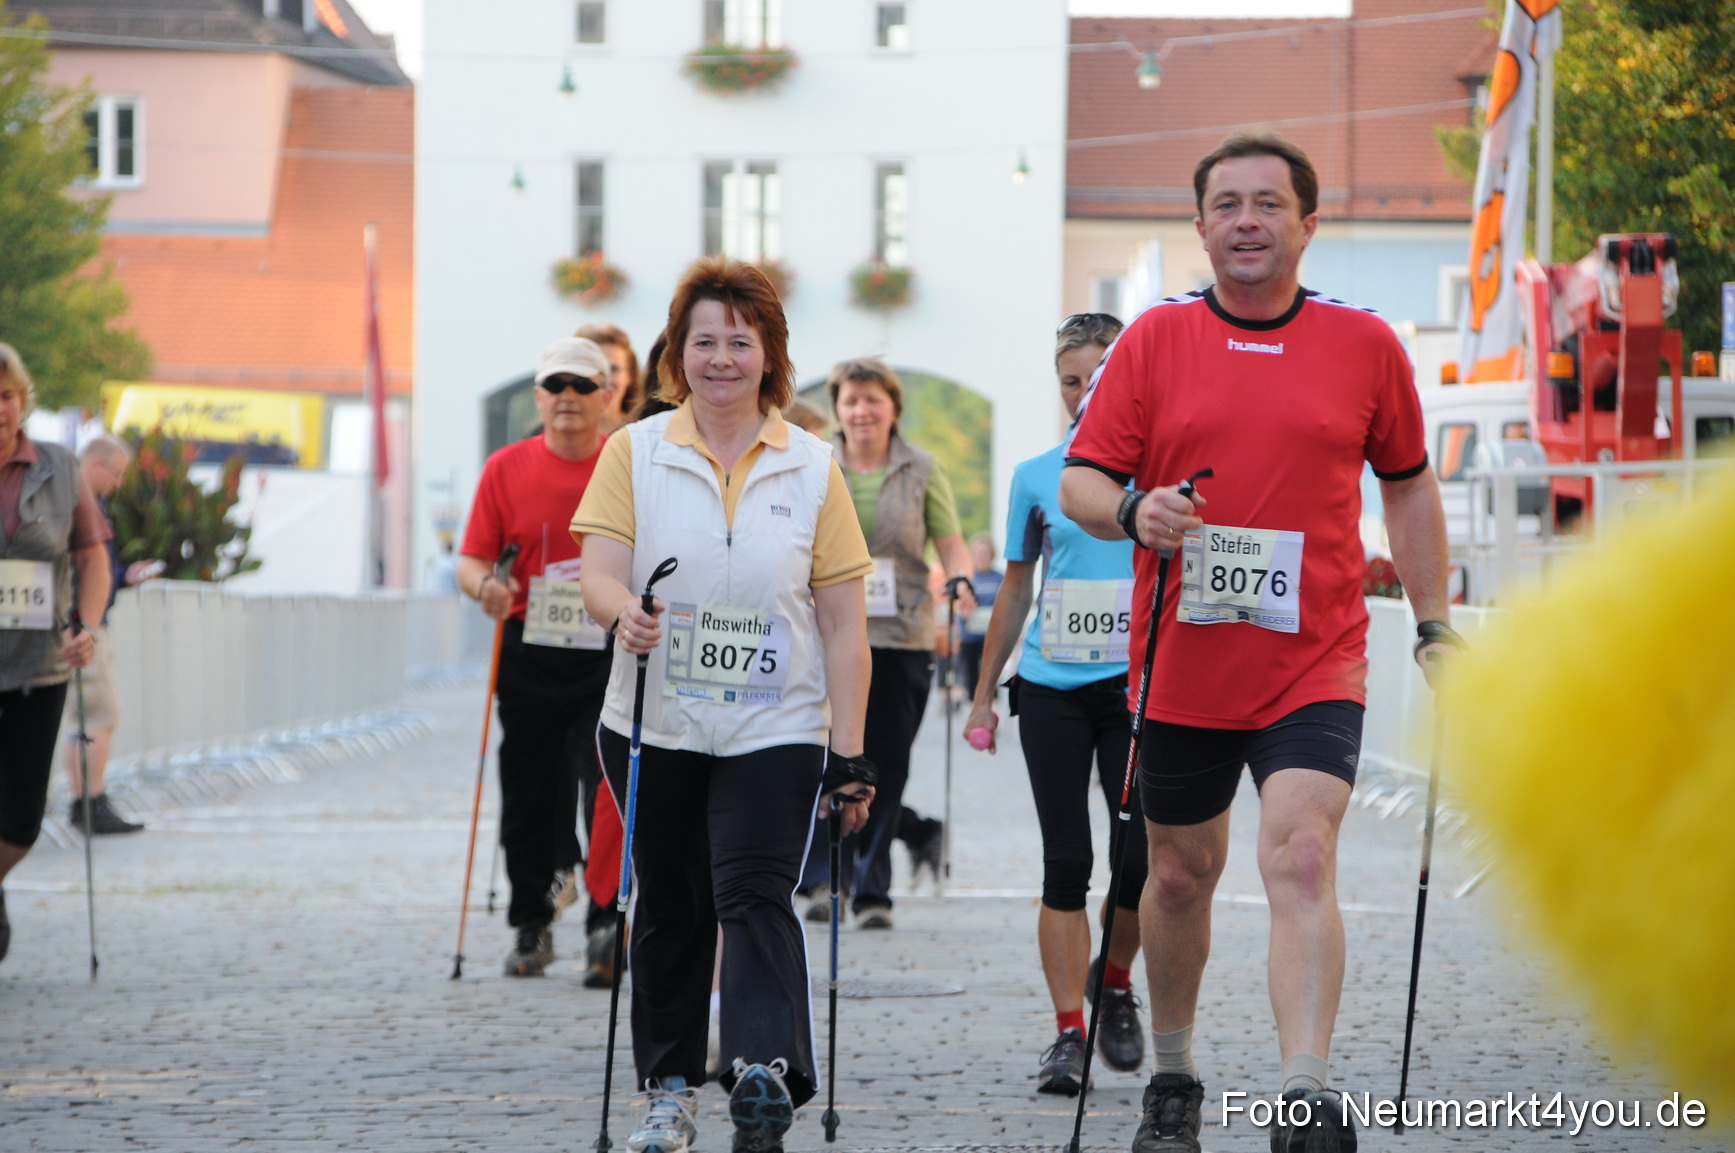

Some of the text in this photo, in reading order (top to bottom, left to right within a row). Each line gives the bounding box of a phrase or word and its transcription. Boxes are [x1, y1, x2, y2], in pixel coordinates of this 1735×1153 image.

[1228, 338, 1284, 354] hummel
[1211, 533, 1261, 556] Stefan
[1211, 565, 1288, 597] 8076
[702, 611, 772, 636] Roswitha
[1068, 612, 1130, 634] 8095
[672, 637, 680, 650] N
[700, 643, 777, 674] 8075
